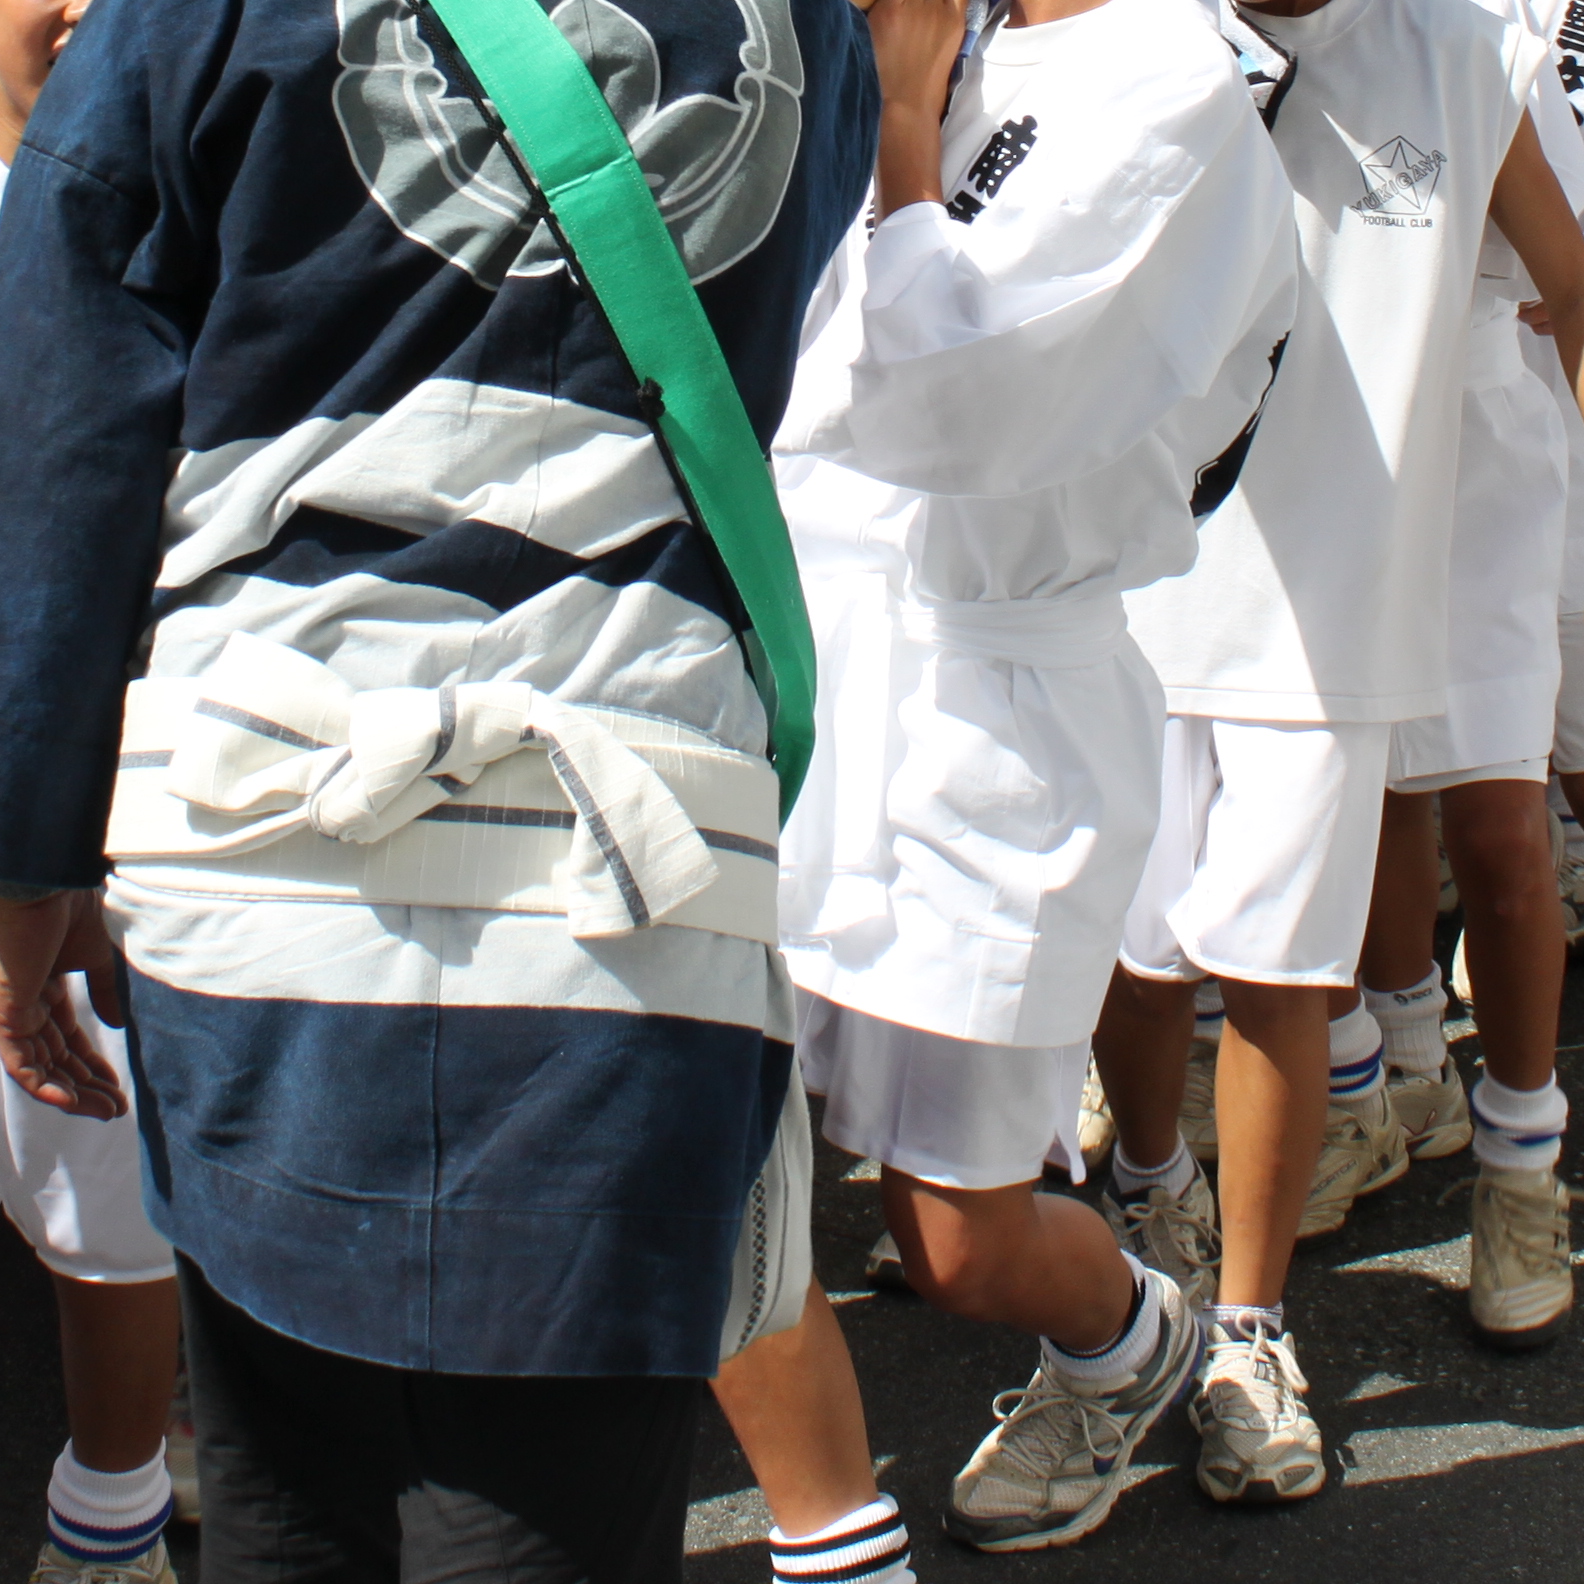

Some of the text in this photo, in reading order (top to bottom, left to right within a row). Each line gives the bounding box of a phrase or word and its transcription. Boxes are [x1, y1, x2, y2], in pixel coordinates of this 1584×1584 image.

[1349, 149, 1447, 218] YUKIGAYA
[1363, 215, 1433, 228] FOOTBALL CLUB
